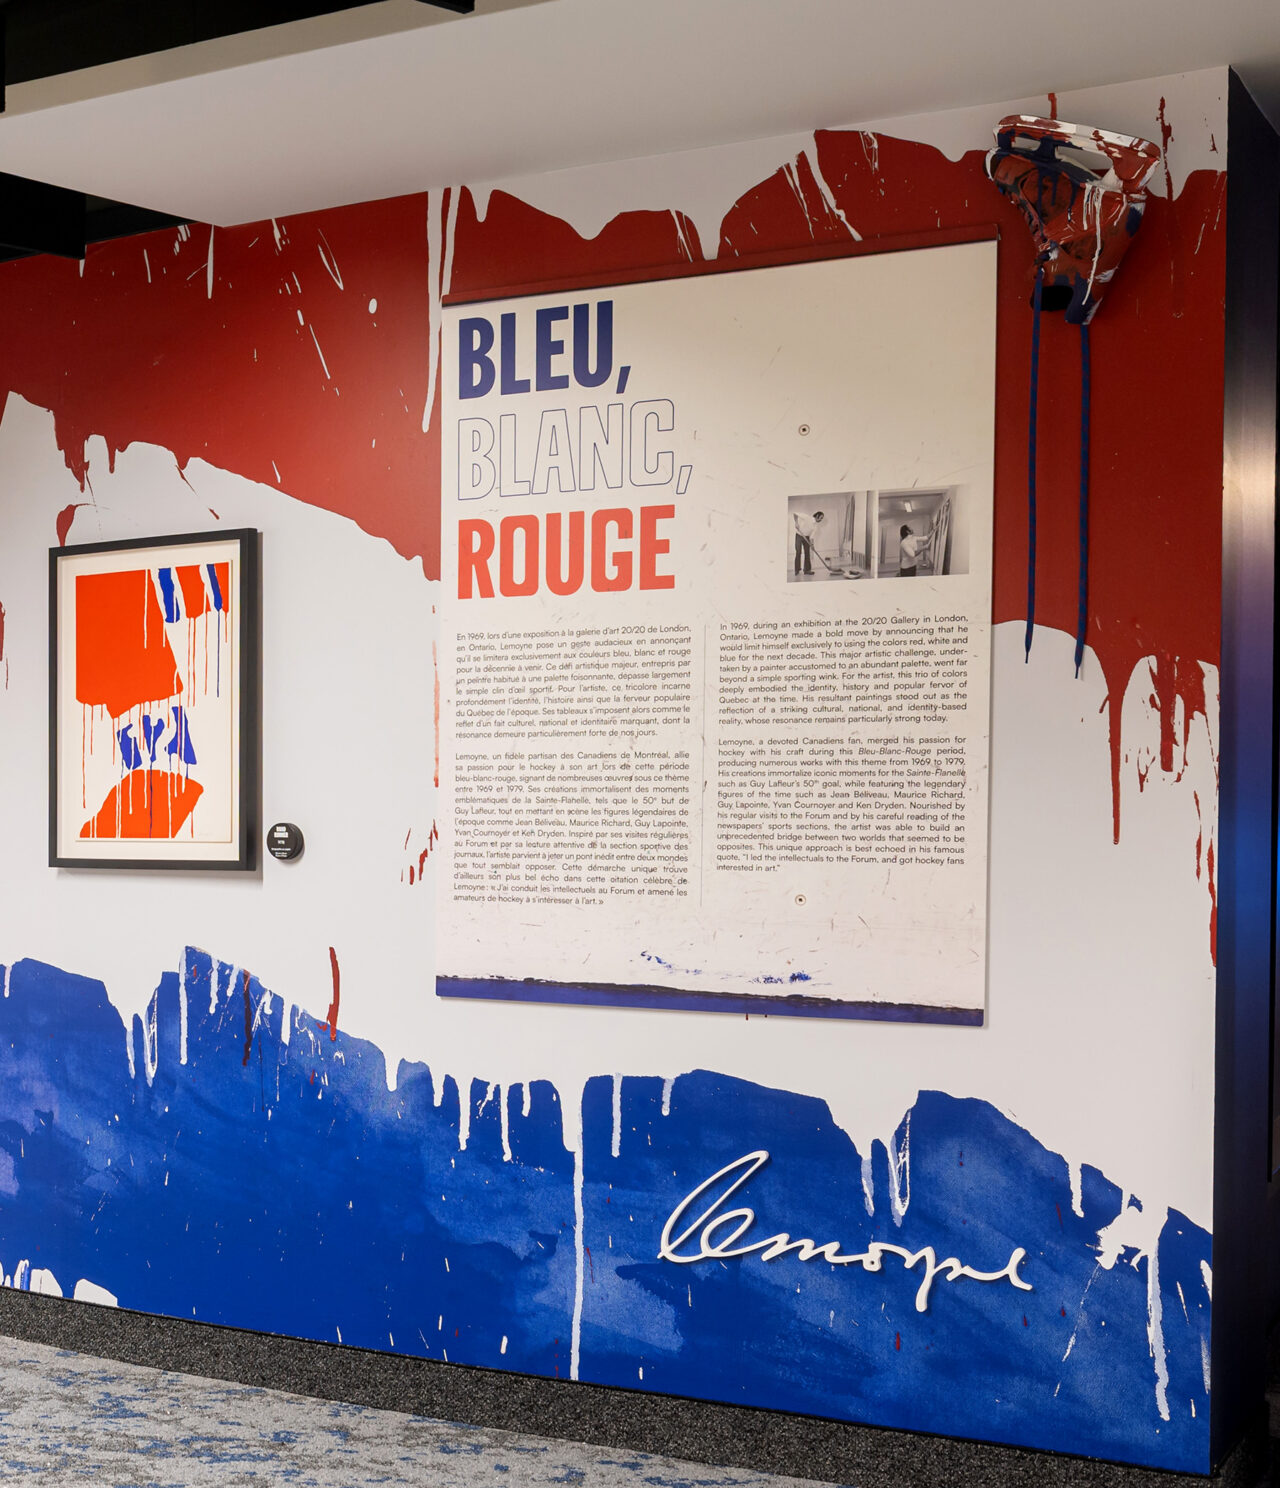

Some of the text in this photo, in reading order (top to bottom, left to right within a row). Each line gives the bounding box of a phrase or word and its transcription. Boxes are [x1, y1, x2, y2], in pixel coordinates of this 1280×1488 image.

[458, 300, 631, 399] BLEU,
[457, 398, 693, 500] BLANC,
[457, 504, 675, 599] ROUGE
[720, 622, 727, 630] In
[753, 621, 778, 631] during
[794, 619, 831, 627] exhibition
[834, 618, 842, 626] at
[862, 617, 887, 625] 20/20
[890, 616, 920, 626] Gallery
[923, 615, 931, 623] in
[753, 631, 788, 642] Lemoyne
[792, 630, 813, 638] made
[825, 629, 843, 637] bold
[872, 628, 882, 637] by
[886, 626, 934, 637] announcing
[938, 625, 954, 633] that
[500, 641, 532, 652] Lemoyne
[536, 642, 554, 650] pose
[570, 639, 590, 649] geste
[594, 638, 632, 646] audacieux
[719, 685, 744, 695] deeply
[748, 684, 787, 692] embodied
[842, 682, 869, 692] history
[893, 681, 925, 691] popular
[930, 680, 956, 688] fervor
[959, 680, 967, 688] of
[528, 752, 557, 761] partisan
[577, 751, 617, 759] Canadiens
[718, 748, 745, 758] hockey
[808, 748, 834, 757] during
[858, 747, 931, 757] Bleu-Blanc-Rouge
[718, 759, 757, 768] producing
[861, 757, 887, 765] theme
[455, 784, 473, 792] entre
[476, 784, 493, 792] 1969
[496, 784, 503, 792] et
[717, 800, 733, 810] Guy
[794, 801, 836, 810] Cournoyer
[955, 802, 965, 811] by
[634, 819, 651, 829] Guy
[768, 822, 792, 832] sports
[917, 823, 925, 831] to
[717, 832, 774, 842] unprecedented
[777, 832, 802, 842] bridge
[841, 833, 856, 841] two
[907, 834, 940, 842] seemed
